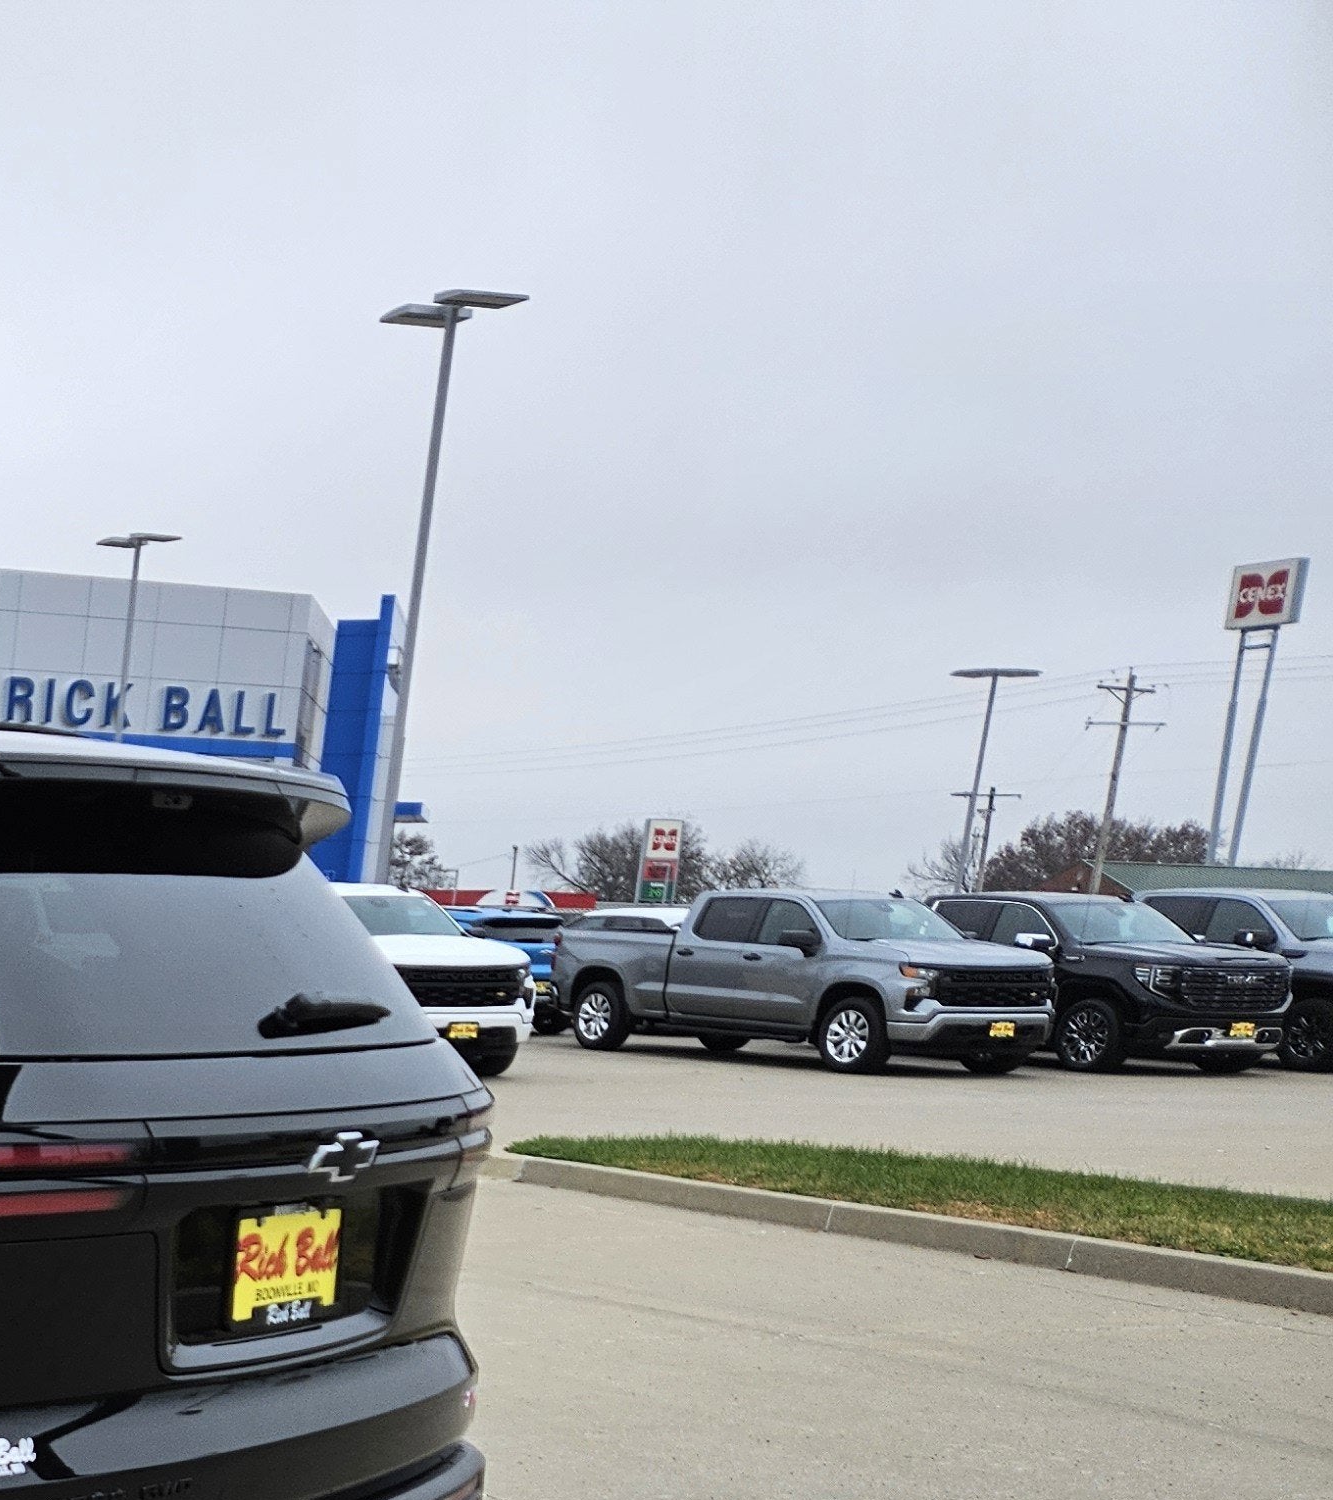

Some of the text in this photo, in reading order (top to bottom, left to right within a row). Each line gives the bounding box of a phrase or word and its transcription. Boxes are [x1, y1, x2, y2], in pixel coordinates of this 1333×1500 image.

[1239, 582, 1286, 603] CENEX
[6, 675, 286, 736] RICK BALL
[234, 1226, 340, 1282] Rick Ball
